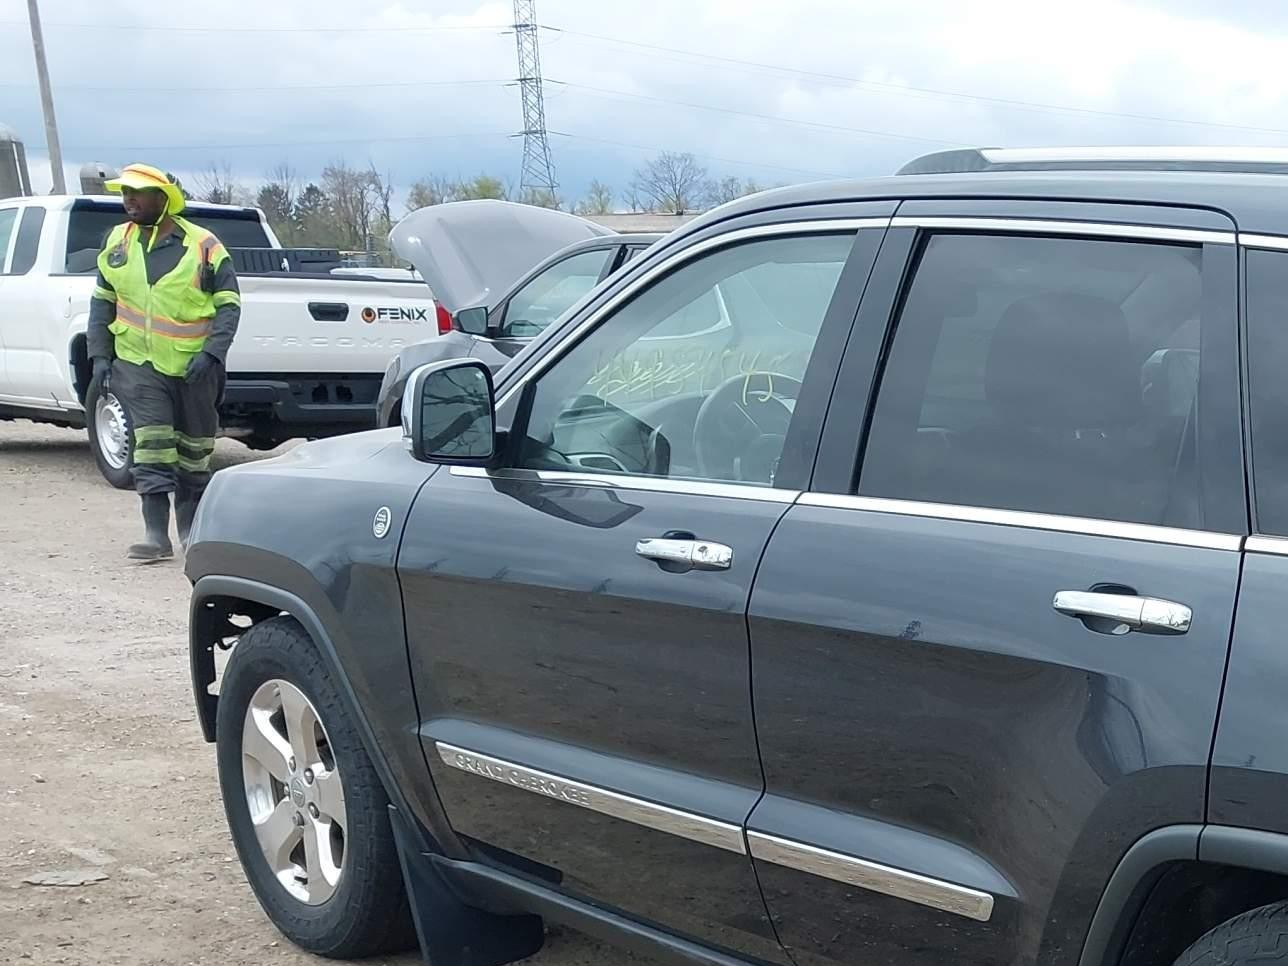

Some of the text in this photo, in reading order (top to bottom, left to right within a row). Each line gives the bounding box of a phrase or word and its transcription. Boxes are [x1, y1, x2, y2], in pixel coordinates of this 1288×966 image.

[377, 307, 427, 322] FENIX
[252, 335, 408, 348] TACOMA
[455, 753, 591, 806] GRAND CHEROKEE
